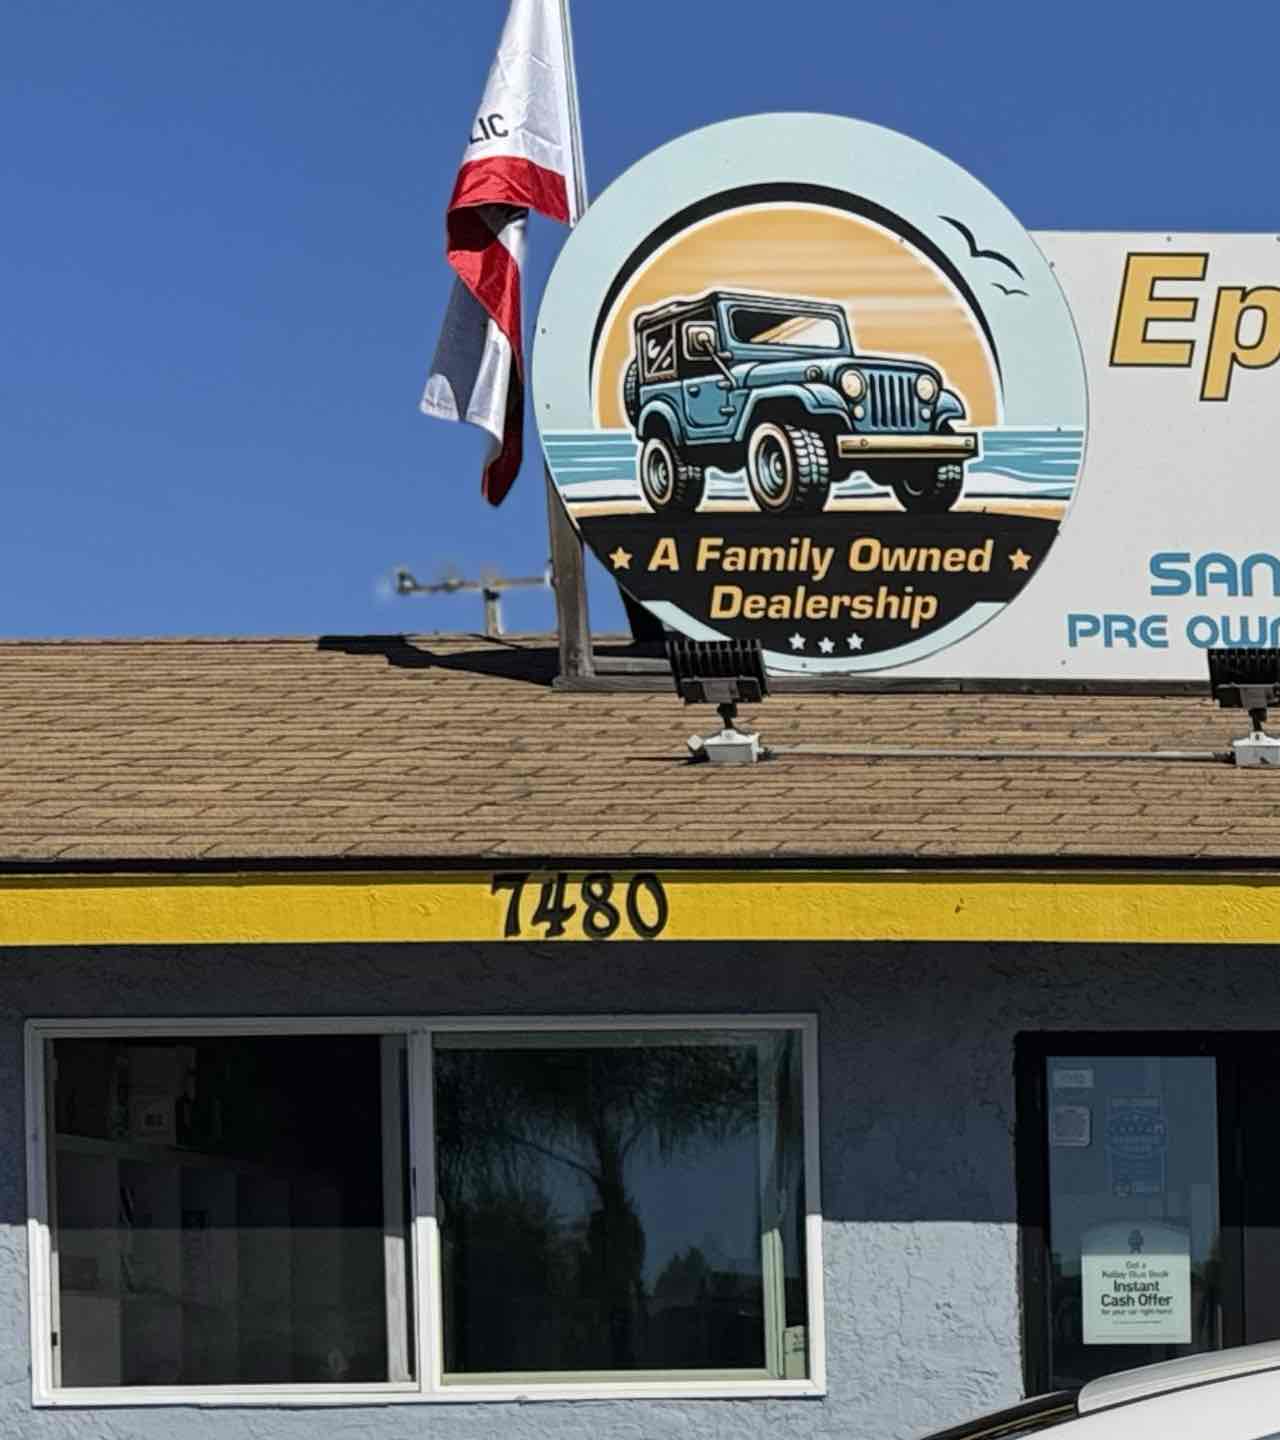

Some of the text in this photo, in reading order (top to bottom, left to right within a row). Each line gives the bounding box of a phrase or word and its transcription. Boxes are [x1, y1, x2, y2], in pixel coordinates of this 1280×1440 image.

[647, 537, 995, 582] A Family Owned
[709, 585, 939, 629] Dealership
[1067, 613, 1170, 649] PRE
[491, 871, 669, 939] 7480
[1101, 1293, 1174, 1307] Cash Offer
[1113, 1279, 1160, 1293] Instant
